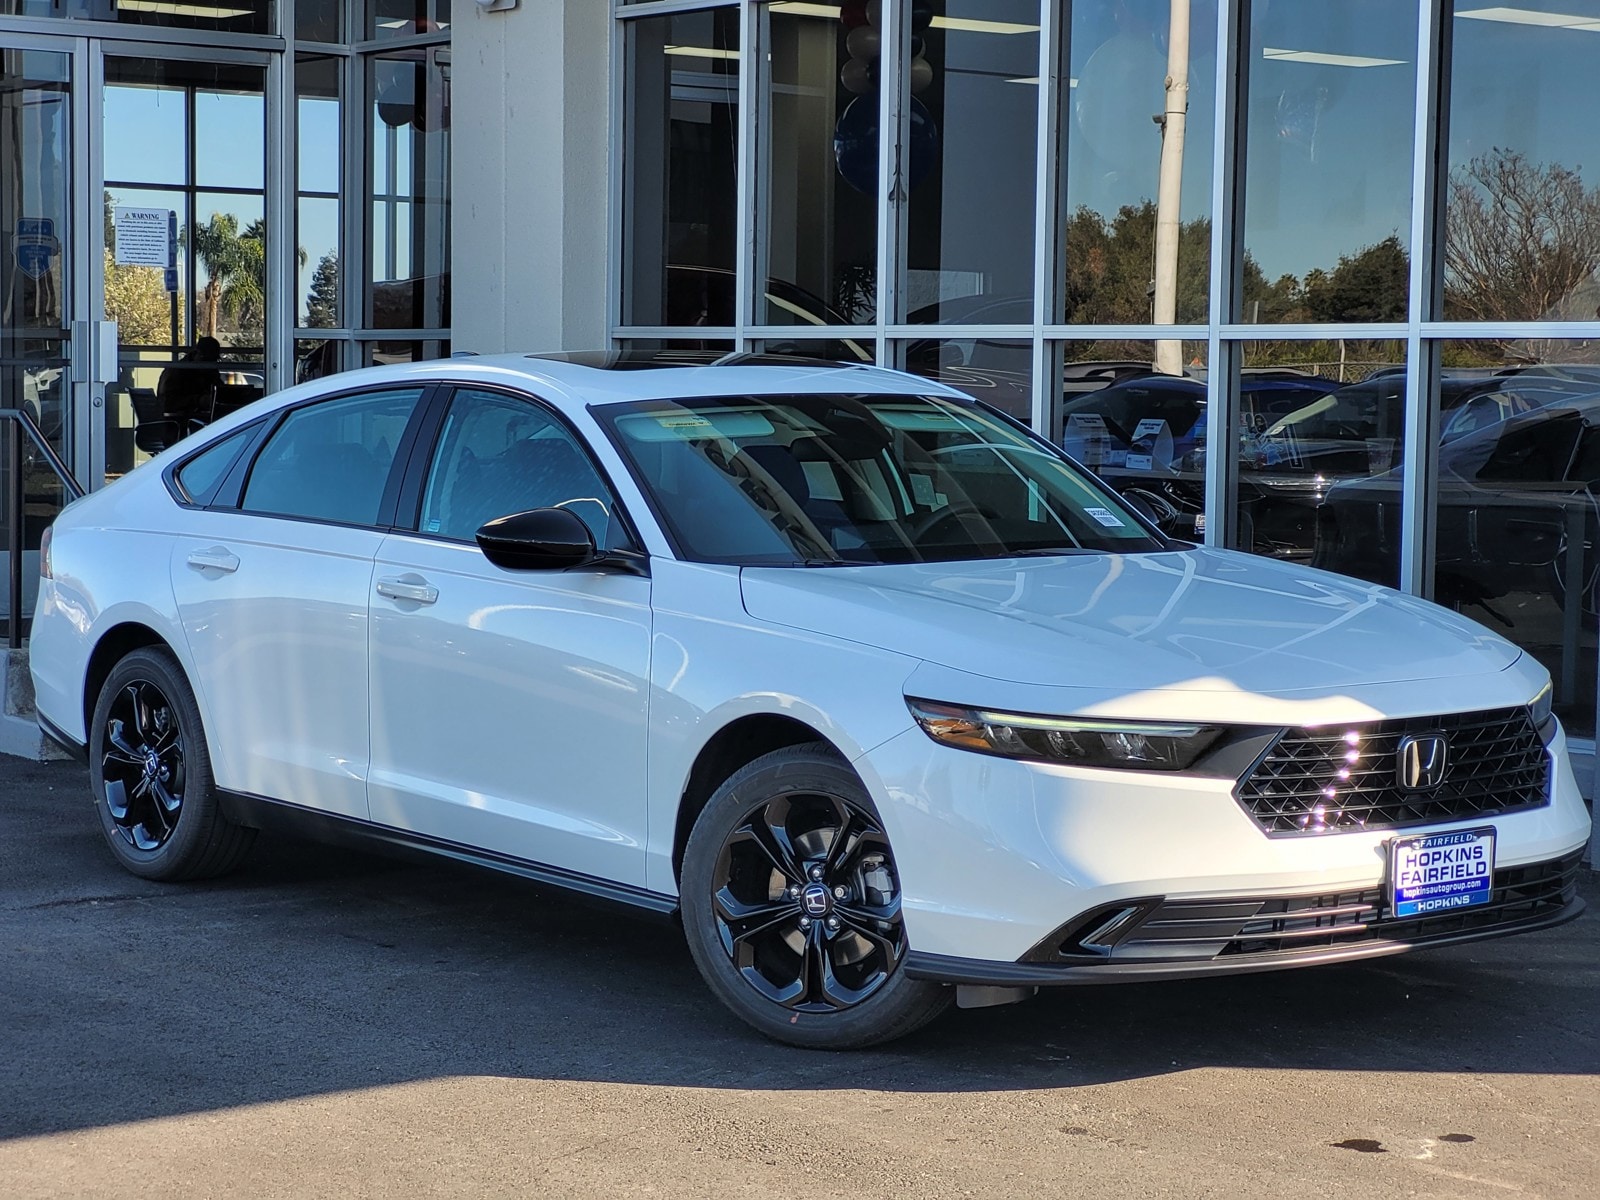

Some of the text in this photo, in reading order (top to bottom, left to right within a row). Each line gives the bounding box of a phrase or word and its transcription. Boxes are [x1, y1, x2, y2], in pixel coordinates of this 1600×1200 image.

[132, 212, 160, 220] WARNING
[1420, 833, 1474, 848] FAIRFIELD
[1406, 845, 1483, 868] HOPKINS
[1401, 861, 1487, 885] FAIRFIELD
[1403, 879, 1481, 898] hopkinsautogroup.com
[1418, 895, 1470, 911] HOPKINS
